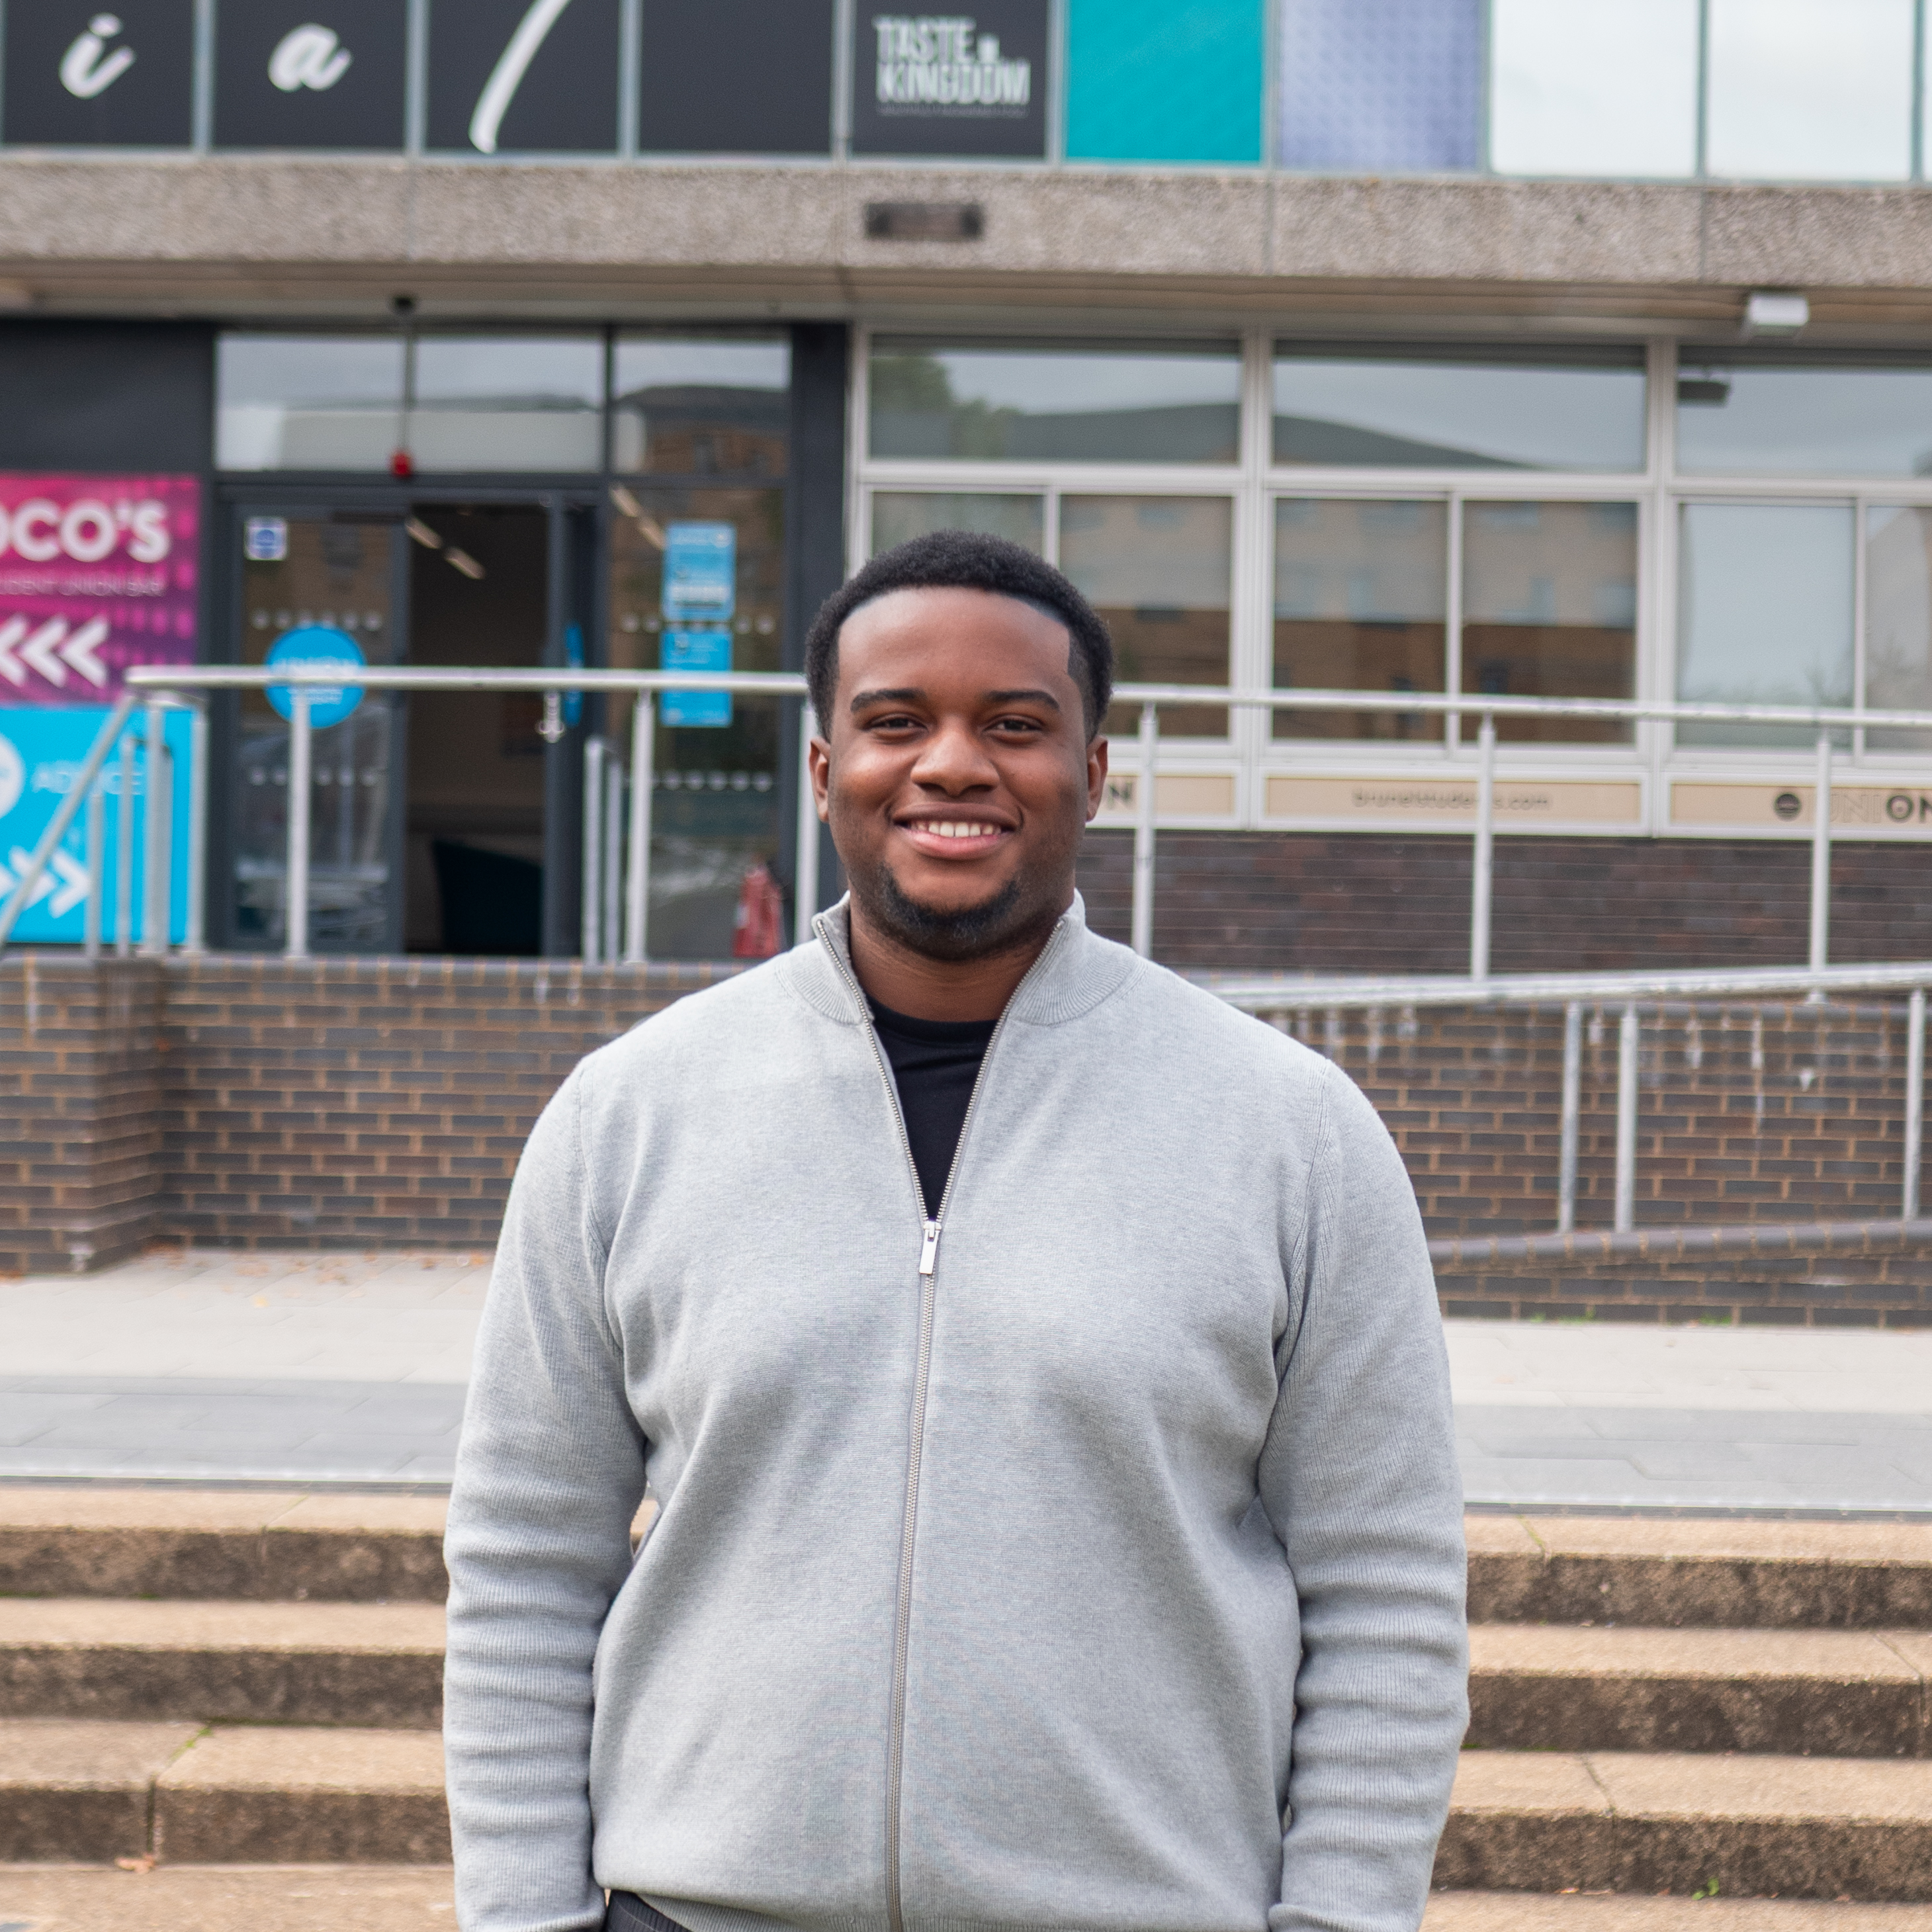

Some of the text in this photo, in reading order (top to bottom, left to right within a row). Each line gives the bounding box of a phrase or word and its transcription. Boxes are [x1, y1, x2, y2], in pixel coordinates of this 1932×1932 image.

[873, 16, 975, 64] TASTE
[876, 60, 1030, 105] KINGDOM
[0, 498, 171, 562] CO'S
